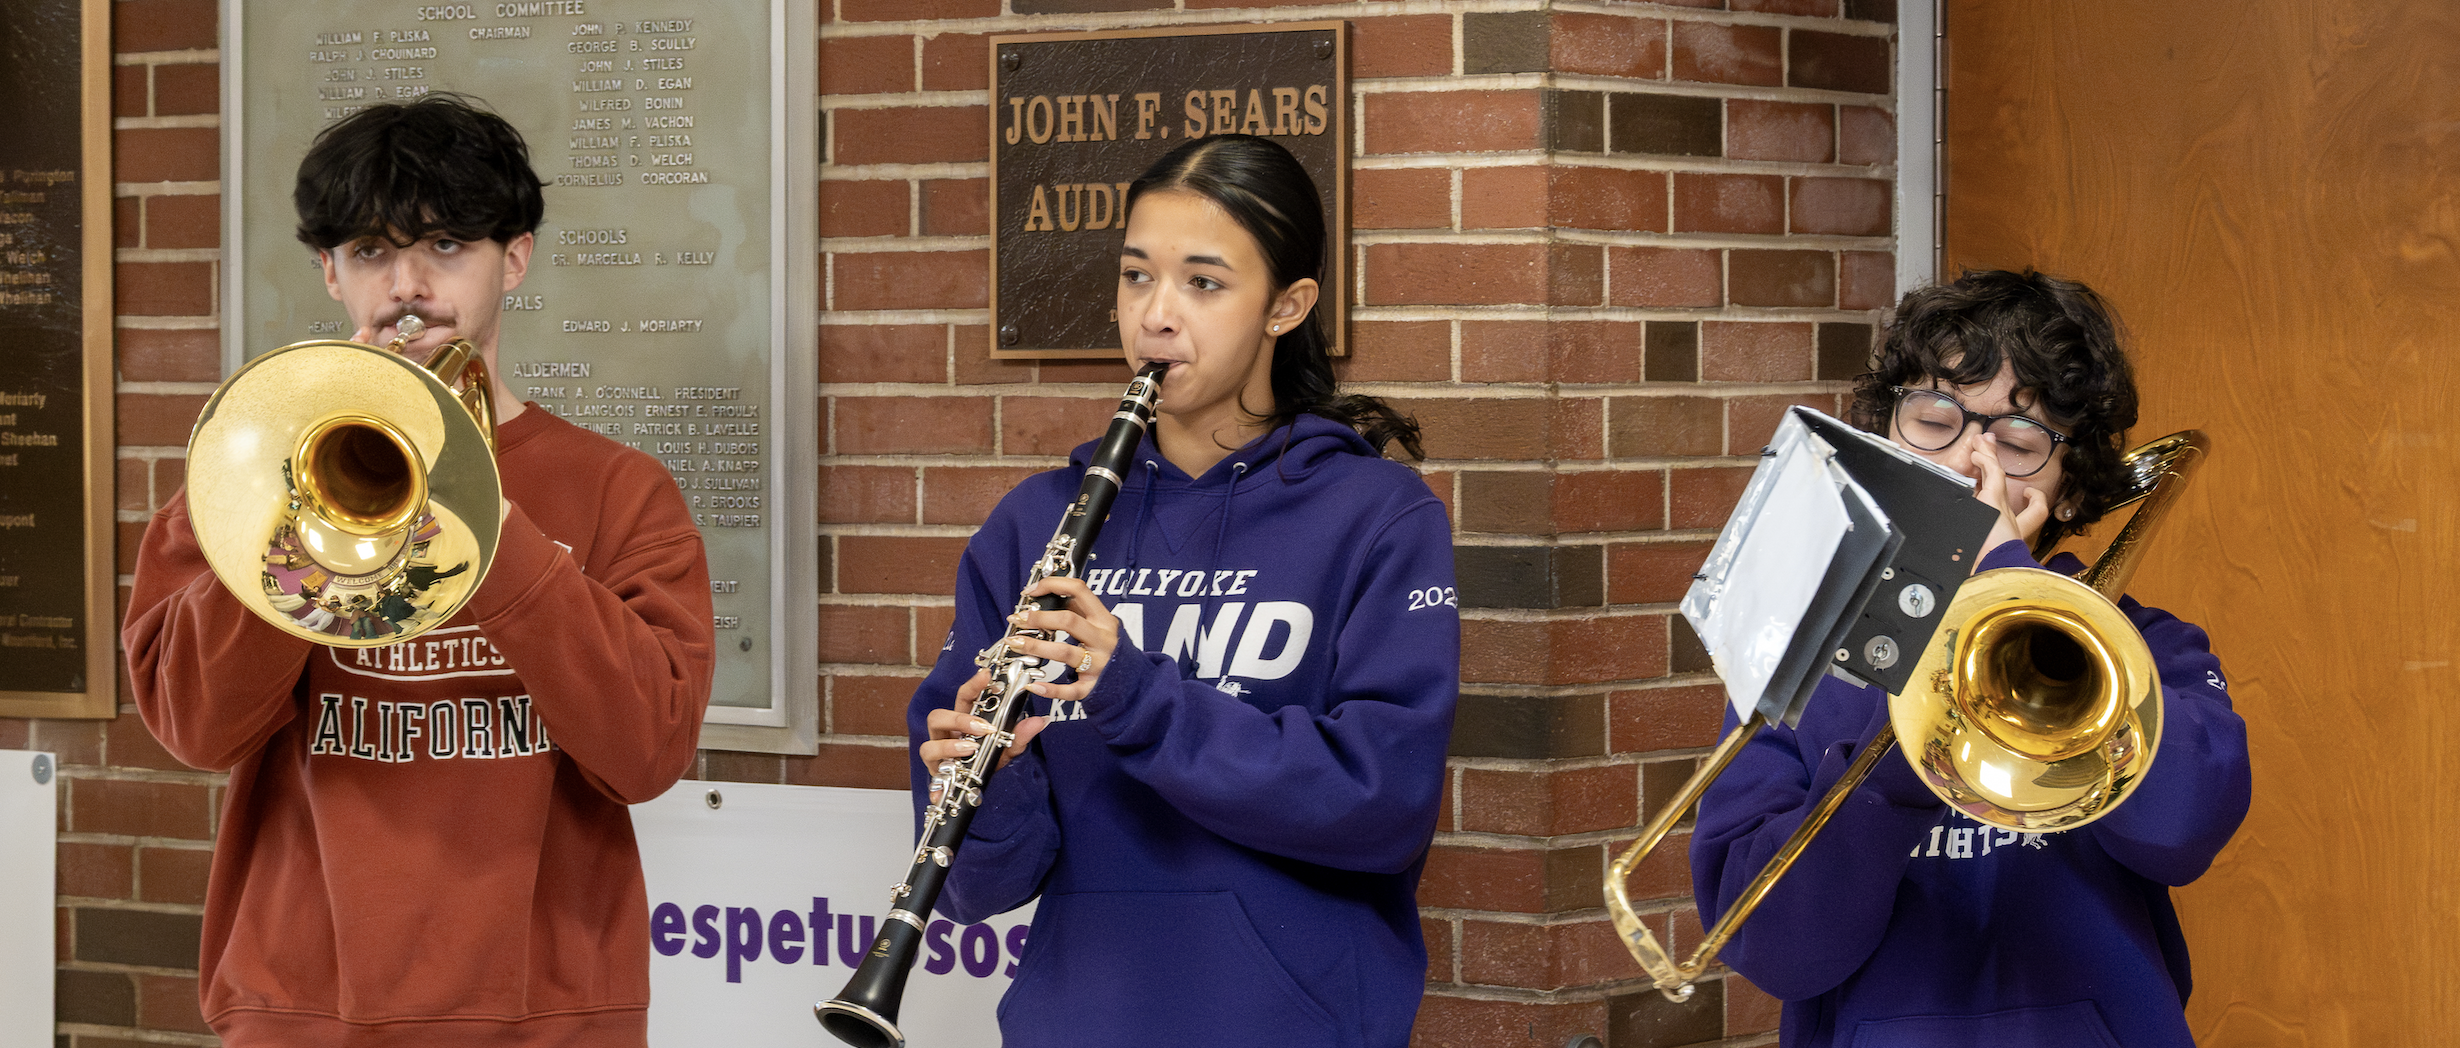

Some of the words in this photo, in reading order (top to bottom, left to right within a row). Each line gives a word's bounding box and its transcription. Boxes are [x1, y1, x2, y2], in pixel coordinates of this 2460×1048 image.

[417, 5, 476, 20] SCHOOL
[496, 1, 584, 18] COMMITTEE
[316, 32, 361, 45] WILLIAM
[391, 30, 430, 42] PLISKA
[469, 26, 532, 40] CHAIRMAN
[572, 24, 602, 36] JOHN
[635, 20, 693, 33] KENNEDY
[567, 41, 617, 53] GEORGE
[630, 40, 642, 52] B.
[651, 38, 696, 50] SCULLY
[372, 48, 437, 60] CHOUINARD
[385, 67, 423, 79] STILES
[580, 61, 612, 73] JOHN
[623, 60, 634, 72] J.
[643, 58, 683, 70] STILES
[572, 79, 622, 92] WILLIAM
[635, 79, 648, 91] D.
[658, 77, 692, 90] EGAN
[319, 87, 363, 100] WILLIAM
[396, 85, 429, 98] EGAN
[579, 99, 631, 112] WILFRED
[645, 97, 683, 109] BONIN
[1005, 94, 1119, 145] JOHN
[1135, 92, 1169, 140] F.
[1184, 85, 1328, 139] SEARS
[572, 118, 611, 130] JAMES
[622, 118, 636, 129] M.
[645, 116, 693, 128] VACHON
[569, 136, 619, 149] WILLIAM
[629, 136, 641, 148] F.
[650, 135, 692, 147] PLISKA
[568, 155, 618, 168] THOMAS
[630, 154, 642, 167] D.
[651, 153, 693, 166] WELCH
[557, 173, 623, 186] CORNELIUS
[641, 171, 708, 185] CORCORAN
[559, 229, 627, 245] SCHOOLS
[577, 253, 641, 265] MARCELLA
[654, 253, 667, 265] R.
[677, 252, 715, 265] KELLY
[563, 320, 610, 332] EDWARD
[621, 321, 632, 332] J.
[640, 319, 703, 332] MORIARTY
[513, 363, 591, 378] ALDERMEN
[528, 386, 566, 399] FRANK
[575, 387, 588, 399] A.
[675, 387, 741, 400] PRESIDENT
[561, 404, 572, 416] L.
[576, 404, 635, 417] LANGLOIS
[645, 404, 689, 417] ERNEST
[696, 405, 708, 417] E.
[712, 405, 759, 418] PROULX
[633, 423, 681, 435] PATRICK
[688, 424, 700, 436] B.
[706, 423, 759, 436] LAVELLE
[657, 442, 691, 454] LOUIS
[699, 442, 711, 454] H.
[715, 442, 758, 454] DUBOIS
[702, 460, 715, 472] A.
[718, 460, 759, 472] KNAPP
[692, 478, 702, 490] J.
[704, 478, 760, 490] SULLIVAN
[693, 496, 706, 508] R.
[711, 496, 760, 508] BROOKS
[696, 514, 707, 526] S.
[711, 515, 760, 527] TAUPIER
[1085, 568, 1258, 597] HOLYOKE
[356, 636, 505, 671] ATHLETICS
[650, 897, 1030, 984] espetusos
